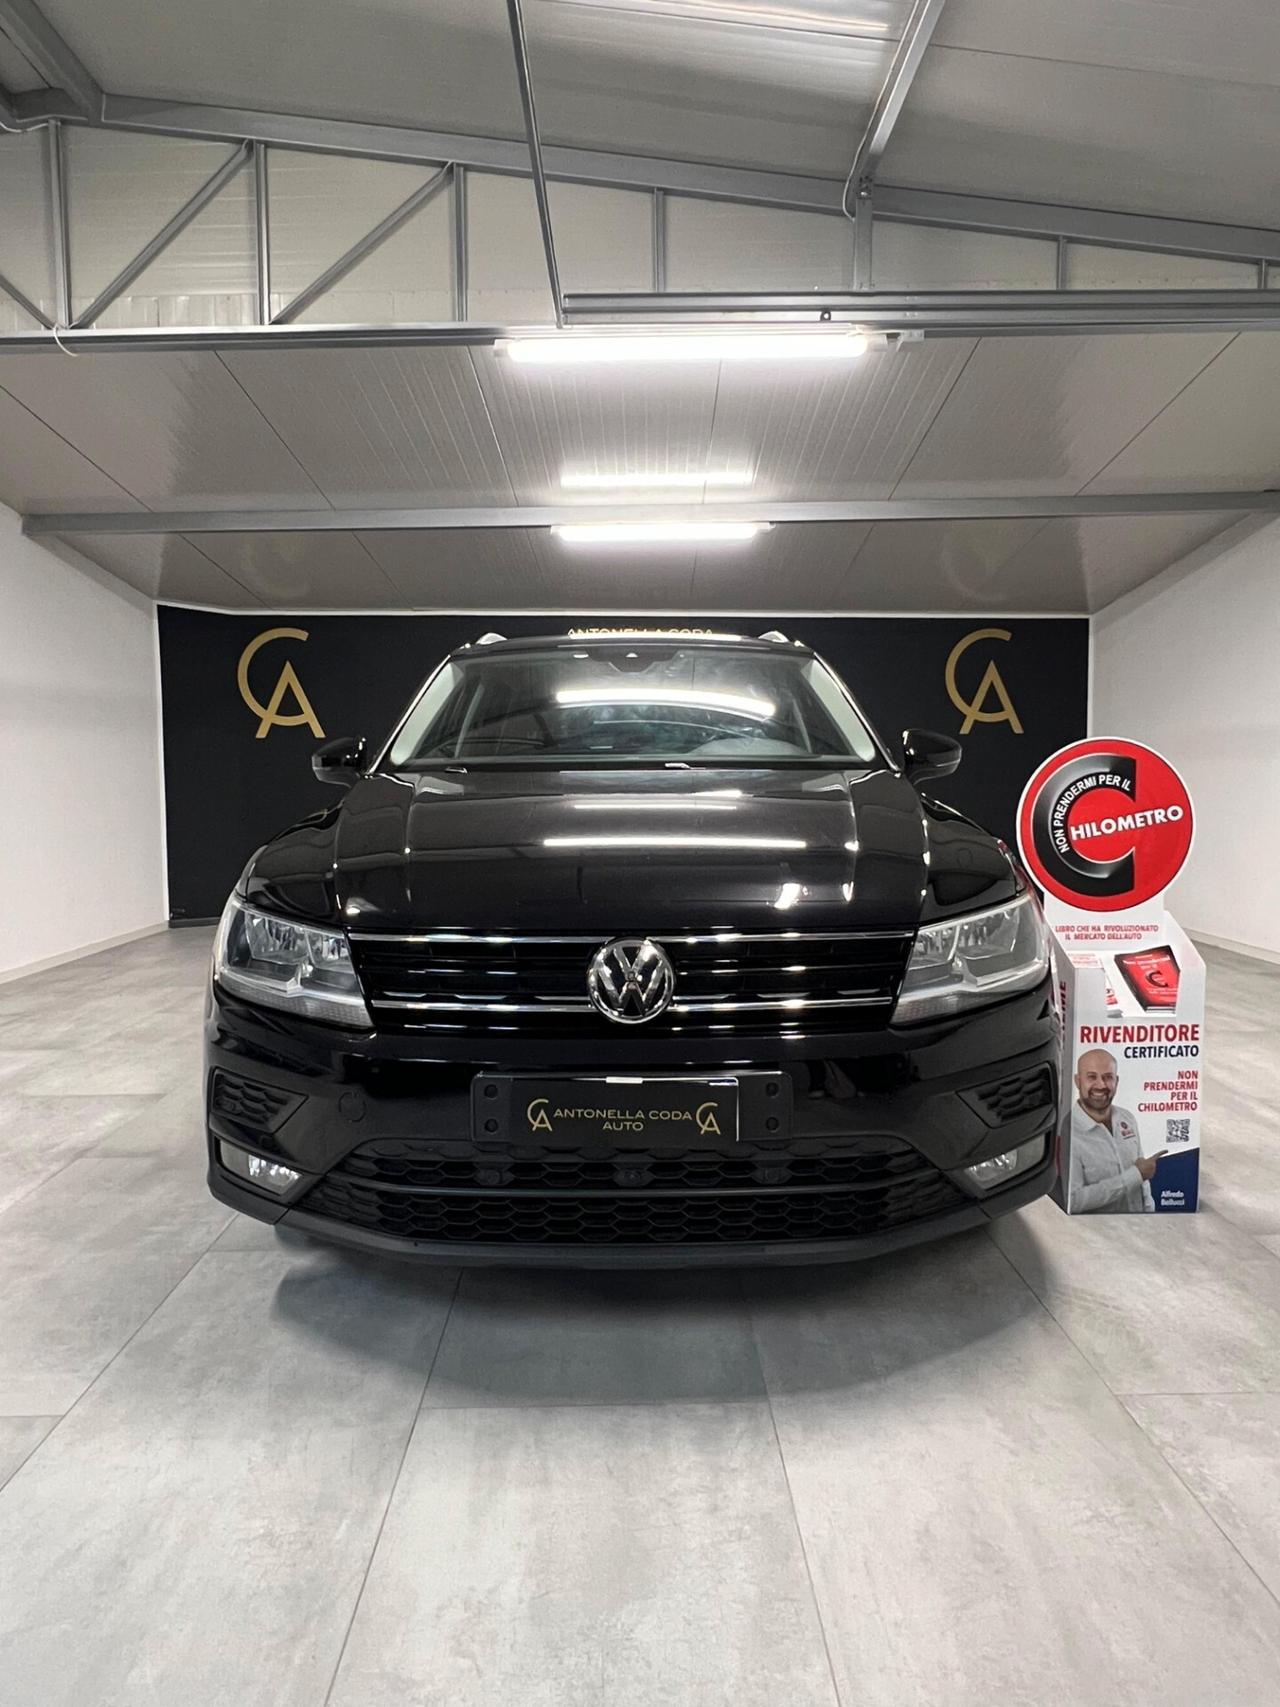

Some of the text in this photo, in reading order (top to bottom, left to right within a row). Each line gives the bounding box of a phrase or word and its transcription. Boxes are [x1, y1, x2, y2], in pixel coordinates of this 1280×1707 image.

[1053, 774, 1132, 854] NON PRENDERMI PER IL
[1055, 925, 1075, 933] LIBRO
[1080, 1024, 1200, 1044] RIVENDITORE
[1124, 1045, 1199, 1059] CERTIFICATO
[1177, 1070, 1198, 1080] NON
[1143, 1081, 1198, 1091] PRENDERMI
[1170, 1091, 1198, 1101] PER IL
[1138, 1102, 1198, 1112] CHILOMETRO
[553, 1108, 645, 1119] ANTONELLA
[649, 1110, 693, 1120] CODA
[602, 1121, 644, 1131] AUTO
